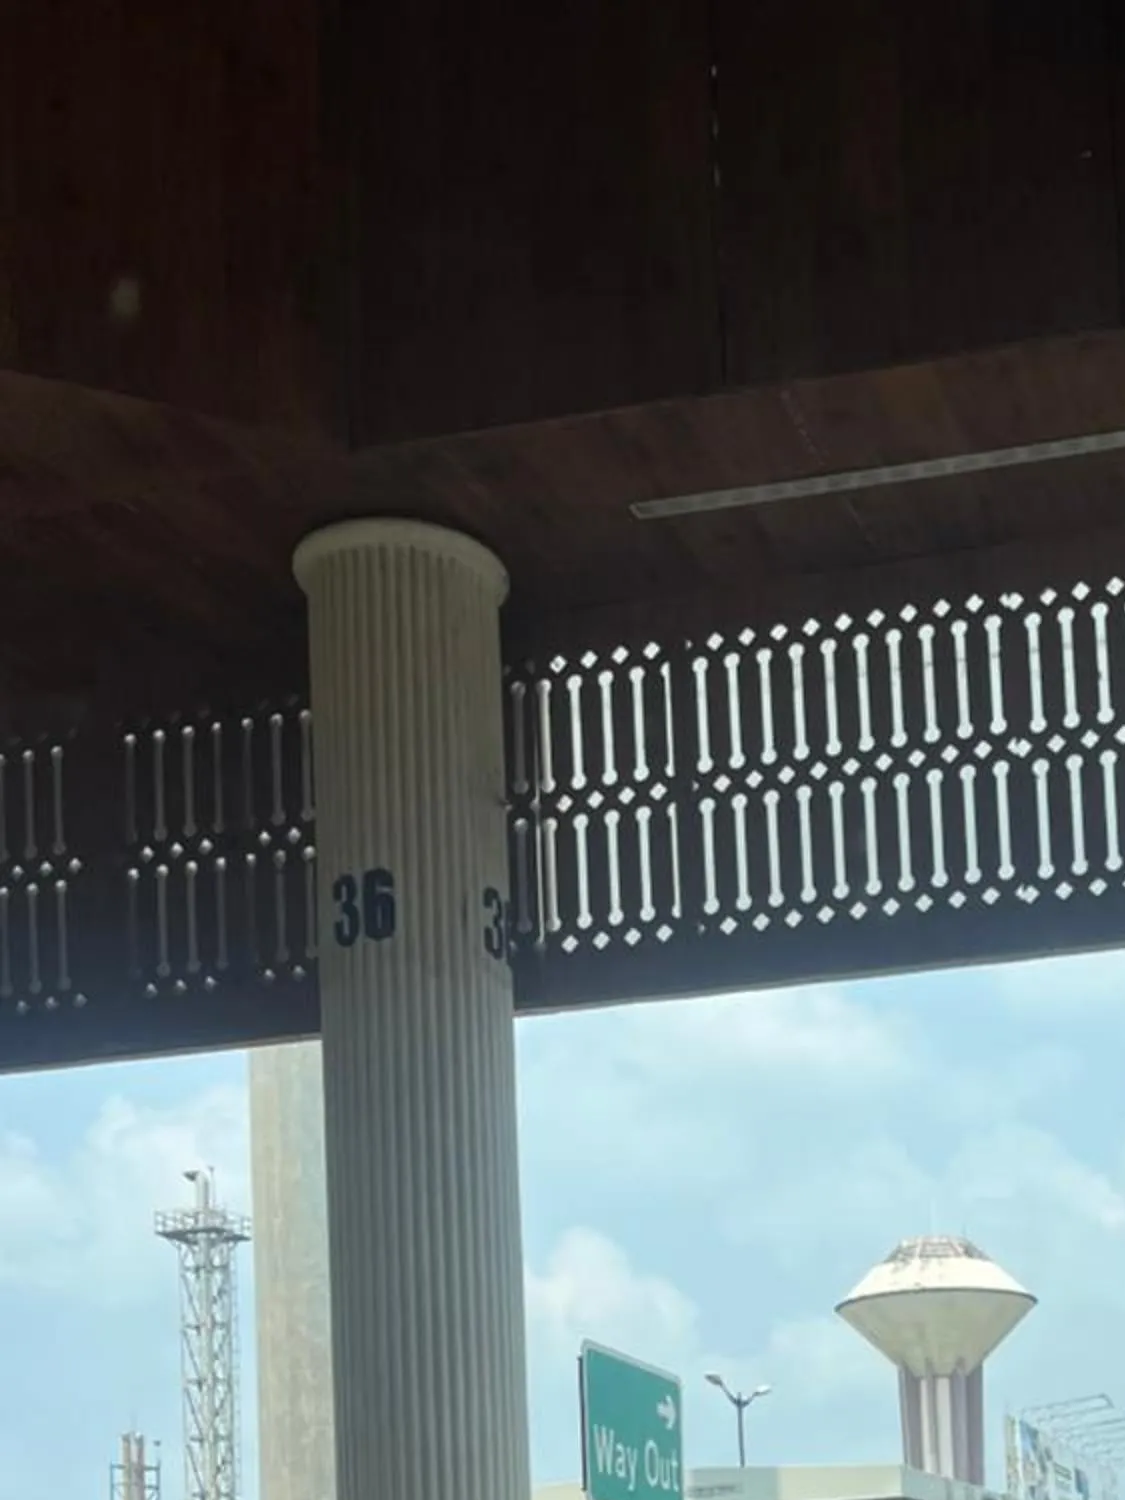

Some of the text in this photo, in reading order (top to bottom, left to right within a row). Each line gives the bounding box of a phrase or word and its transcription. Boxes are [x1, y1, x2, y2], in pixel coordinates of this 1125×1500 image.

[333, 867, 396, 948] 36
[483, 886, 510, 961] 3
[592, 1423, 679, 1492] Way Out
